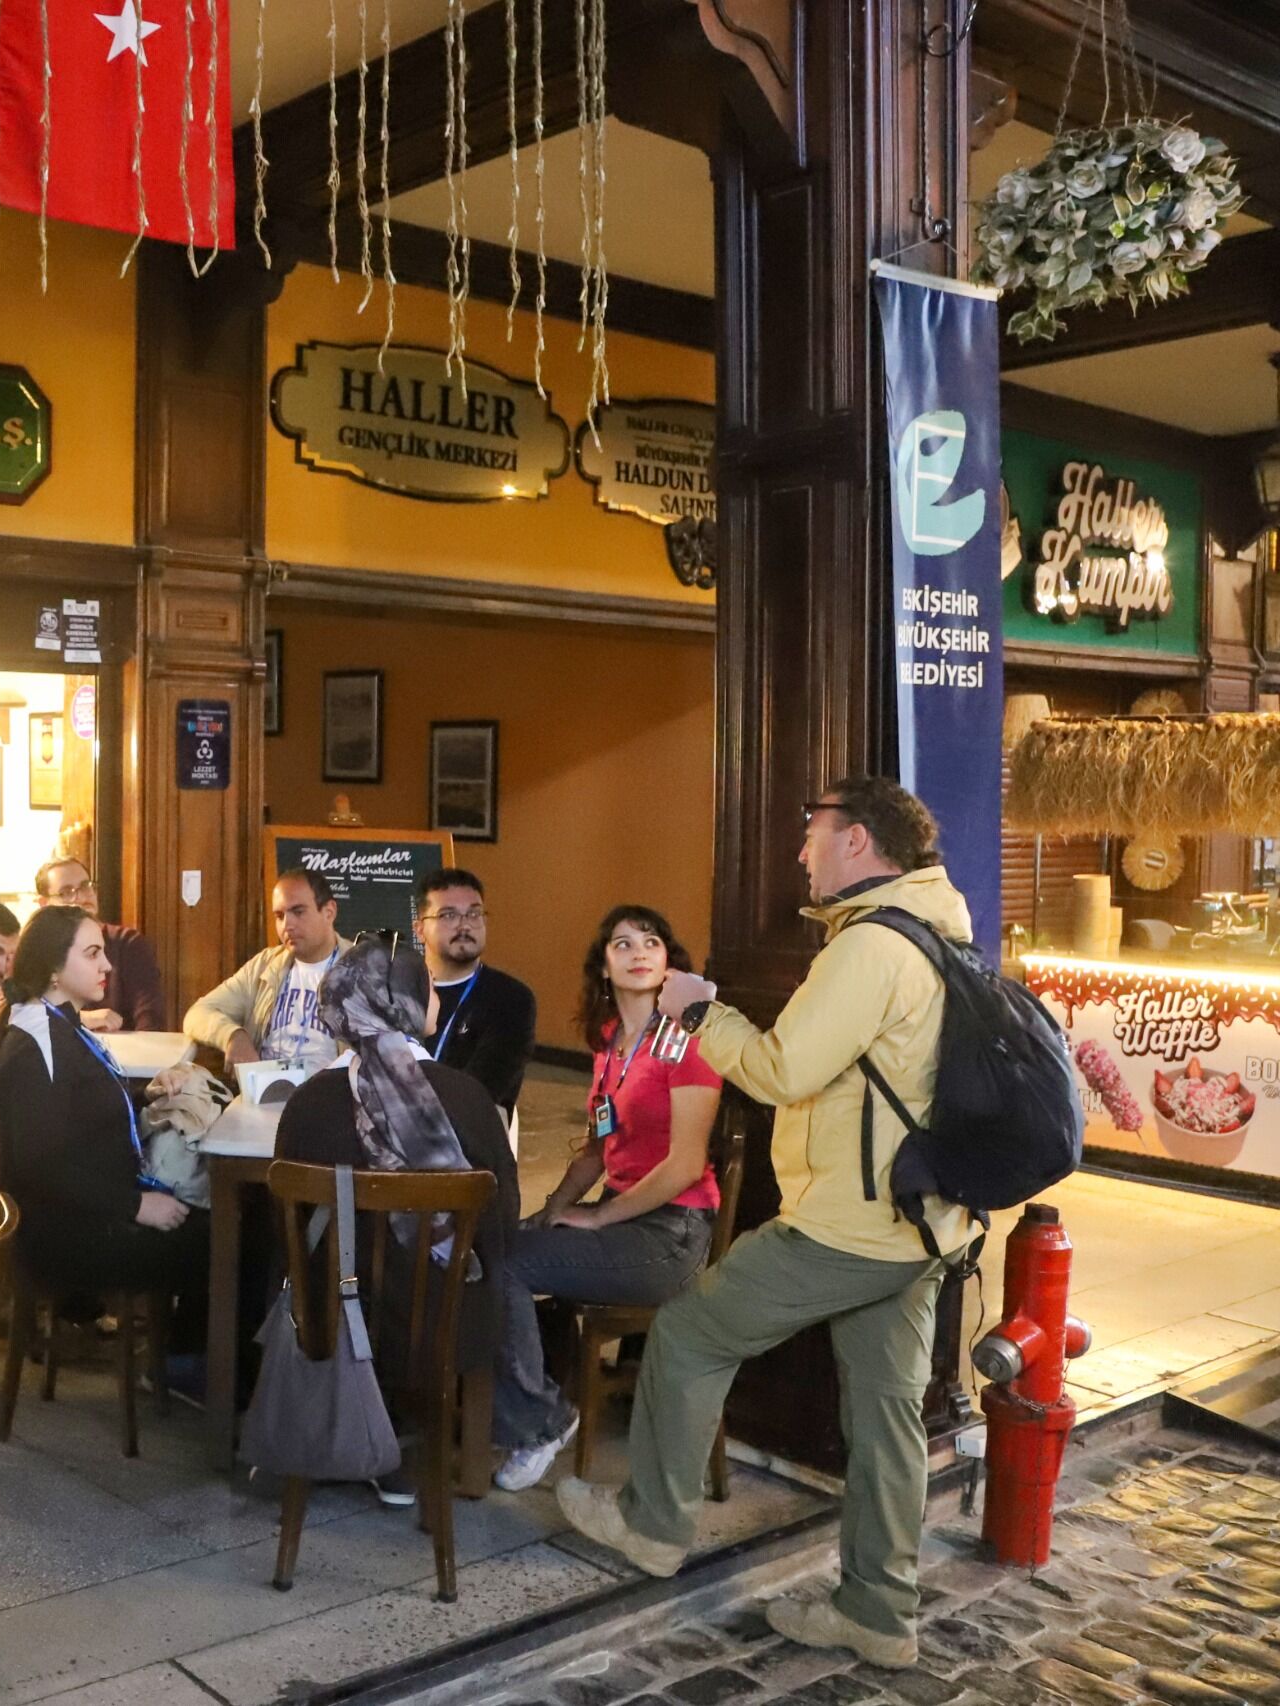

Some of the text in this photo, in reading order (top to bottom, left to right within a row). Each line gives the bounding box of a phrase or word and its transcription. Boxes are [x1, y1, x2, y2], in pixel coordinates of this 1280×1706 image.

[339, 367, 519, 440] HALLER
[338, 426, 518, 473] GENÇLİK MERKEZİ
[615, 460, 694, 492] HALDUN
[1057, 461, 1169, 553] Haller
[1035, 529, 1173, 626] Kumpir
[902, 584, 979, 618] ESKİŞEHİR
[301, 847, 411, 873] Mazlumlar
[1114, 989, 1216, 1025] Haller
[1113, 1018, 1221, 1062] Waffle
